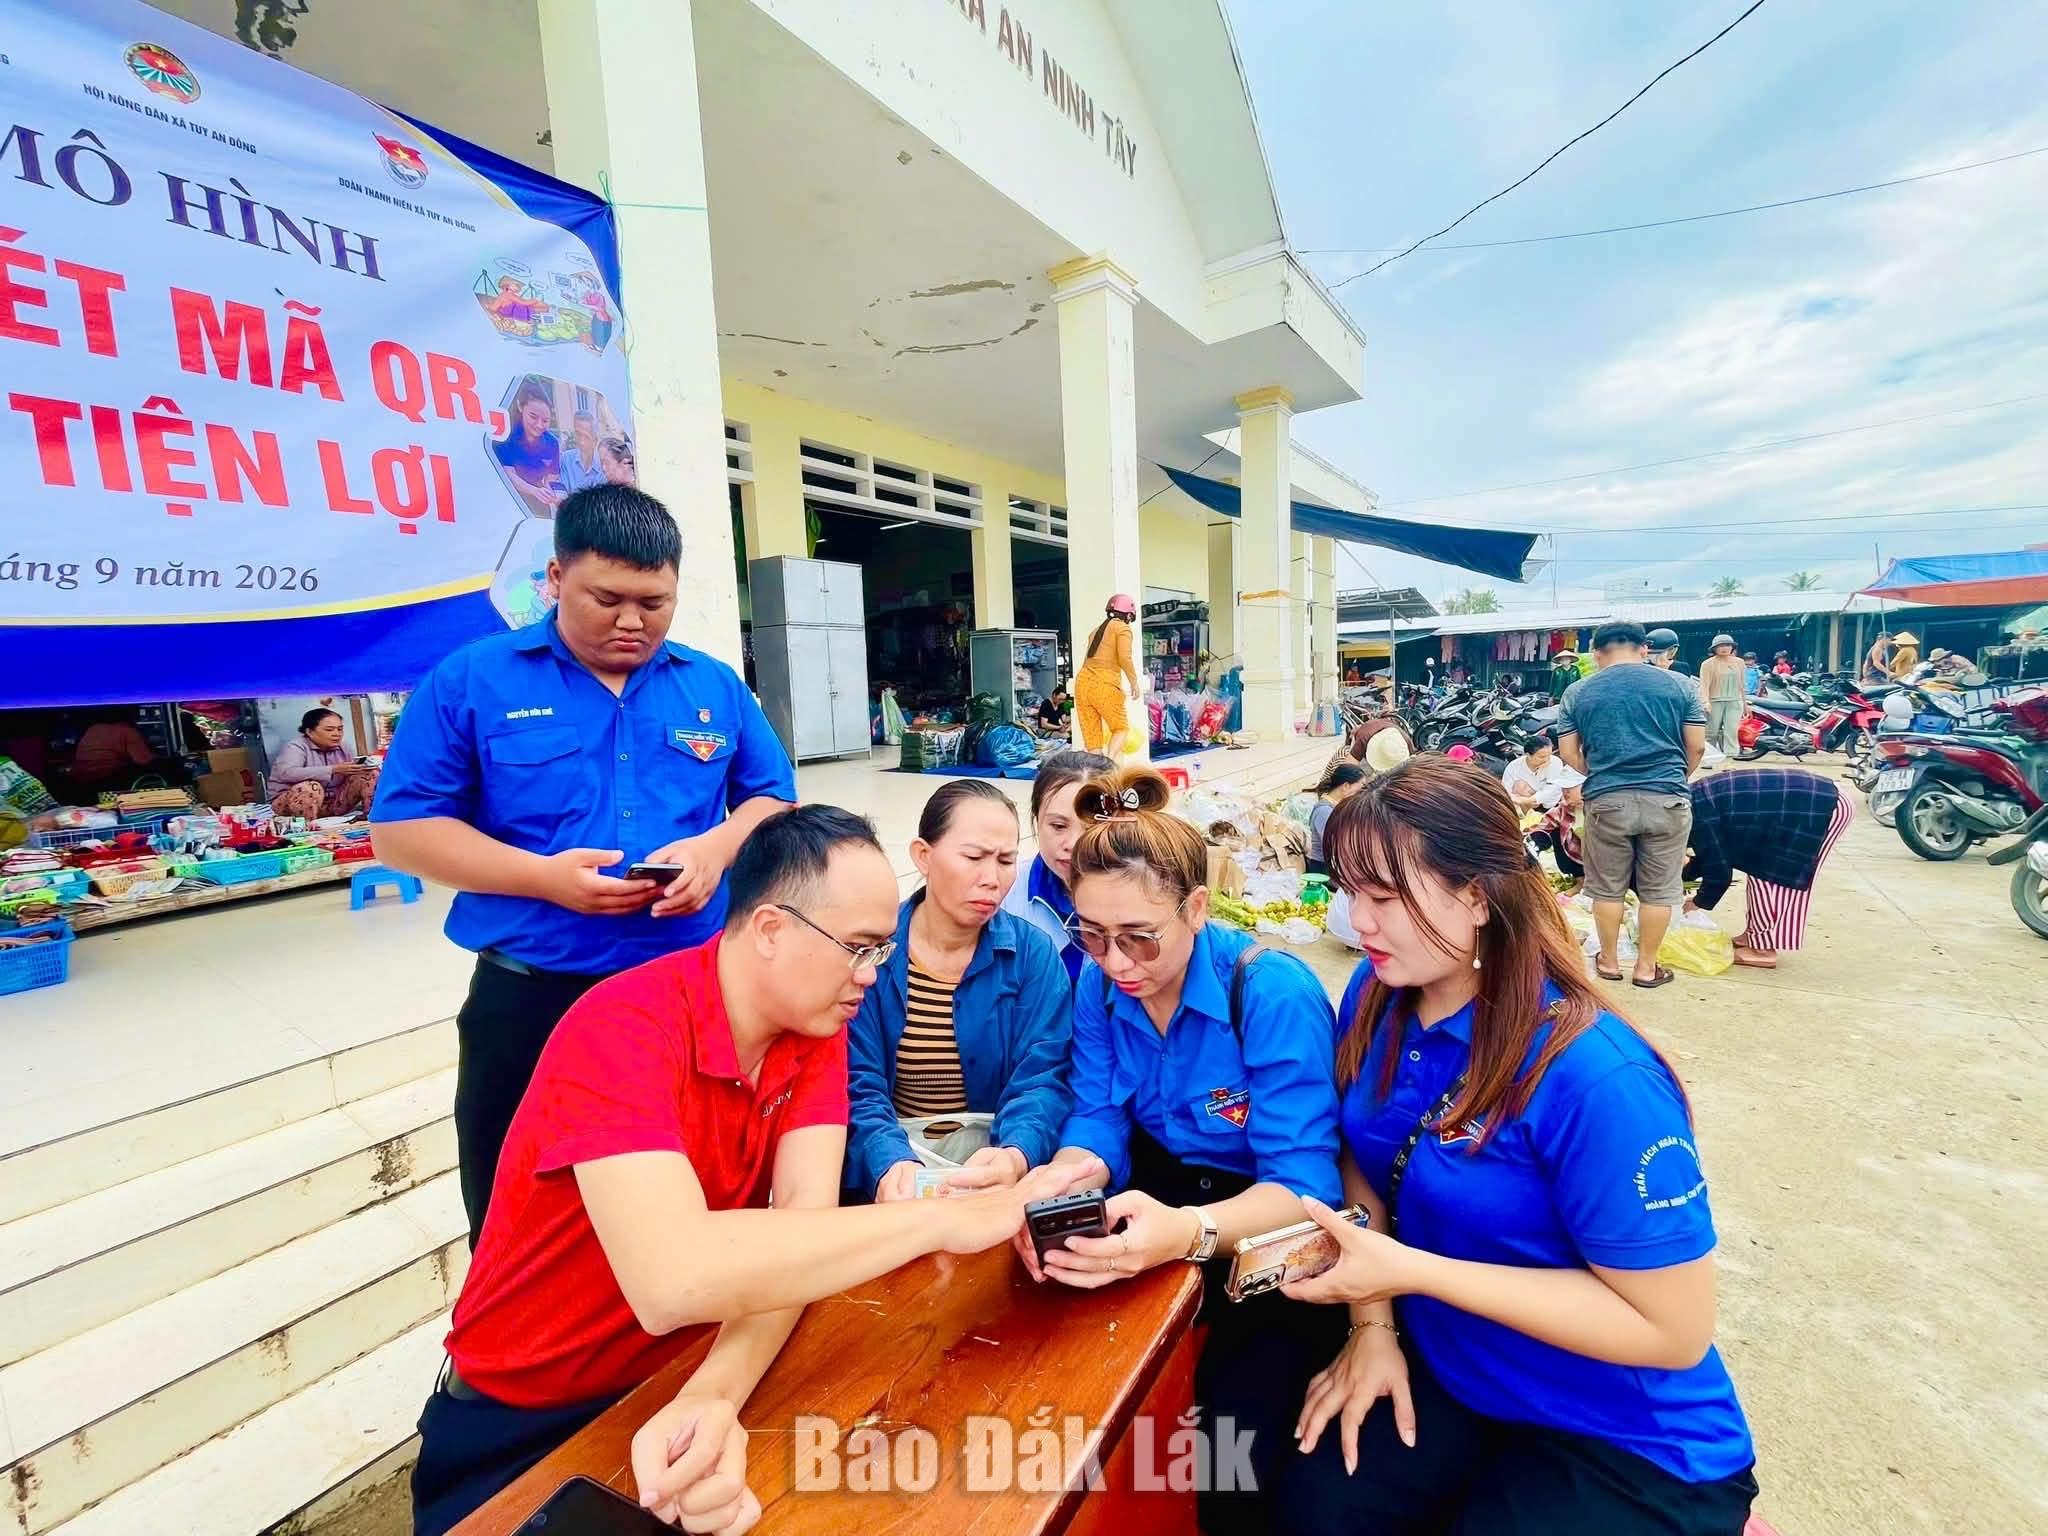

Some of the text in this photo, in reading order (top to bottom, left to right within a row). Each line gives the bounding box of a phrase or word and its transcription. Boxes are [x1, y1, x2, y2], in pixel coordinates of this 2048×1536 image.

[83, 83, 105, 101] HỘI
[108, 92, 142, 113] NÔNG
[171, 115, 187, 130] XÃ
[188, 122, 209, 137] TUY
[211, 130, 227, 144] AN
[998, 8, 1033, 81] AN
[1042, 47, 1096, 139] NINH
[1102, 111, 1137, 178] TÂY
[157, 170, 387, 282] HÌNH
[364, 187, 391, 204] THANH
[426, 209, 441, 221] TUY
[442, 216, 454, 226] AN
[169, 286, 344, 402] MÃ
[370, 339, 507, 436] QR,
[8, 392, 456, 535] TIỆN LỢI
[95, 556, 119, 584] 9
[135, 560, 222, 588] năm
[235, 564, 320, 592] 2026
